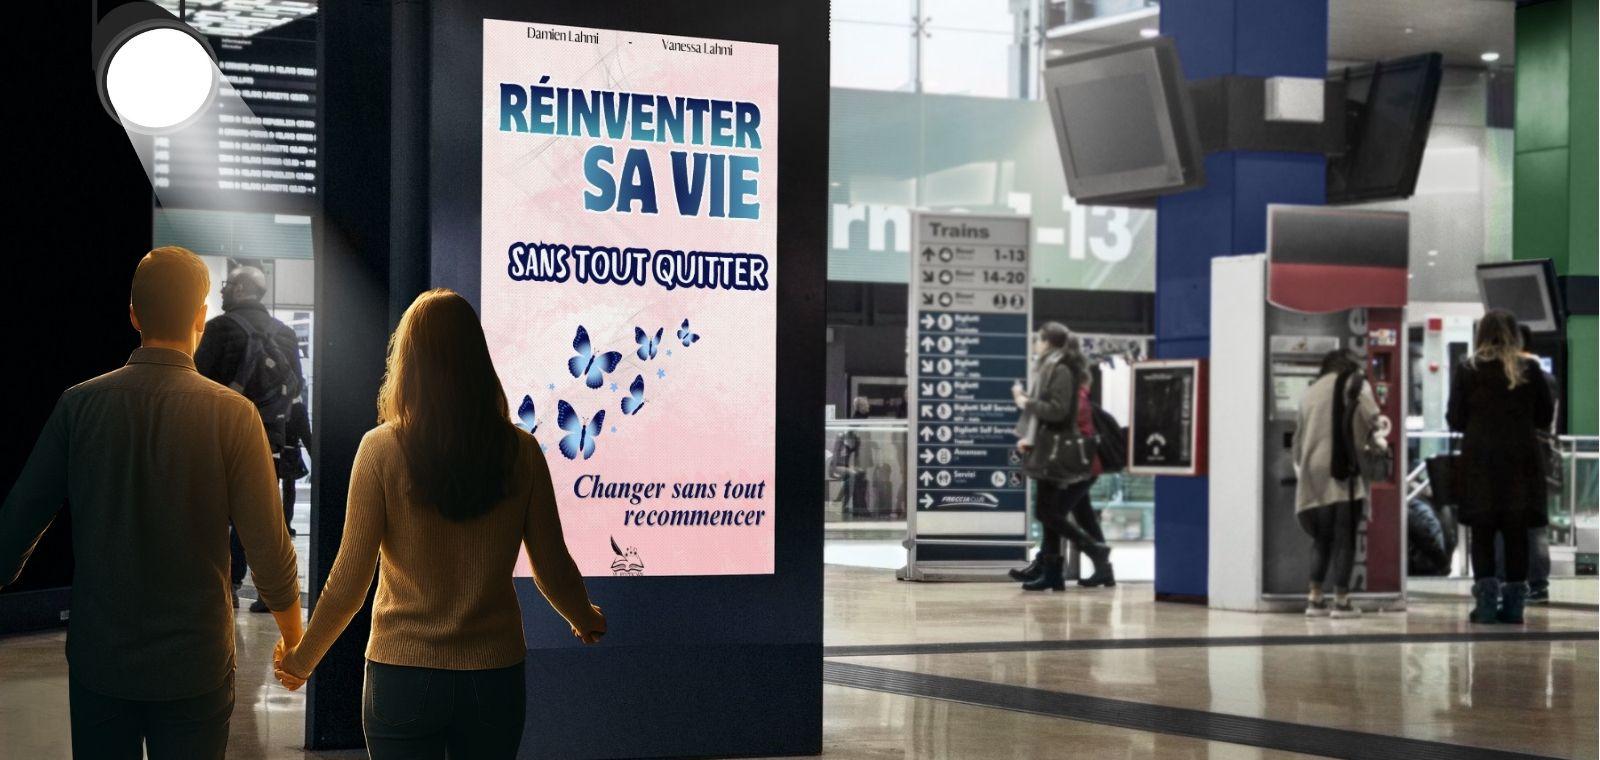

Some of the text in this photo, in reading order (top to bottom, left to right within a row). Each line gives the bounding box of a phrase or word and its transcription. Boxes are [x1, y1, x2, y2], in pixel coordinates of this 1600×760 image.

[526, 26, 566, 41] Damien
[568, 29, 599, 45] Lahmi
[661, 38, 701, 54] Vanessa
[703, 42, 733, 57] Lahmi
[499, 75, 762, 150] RÉINVENTER
[583, 144, 761, 220] SA VIE
[928, 222, 990, 239] Trains
[509, 242, 768, 289] SANS TOUT QUITTER
[994, 249, 1025, 263] 1-13
[983, 270, 1025, 285] 14-20
[573, 474, 766, 504] Changer sans tout
[624, 509, 766, 527] recommencer
